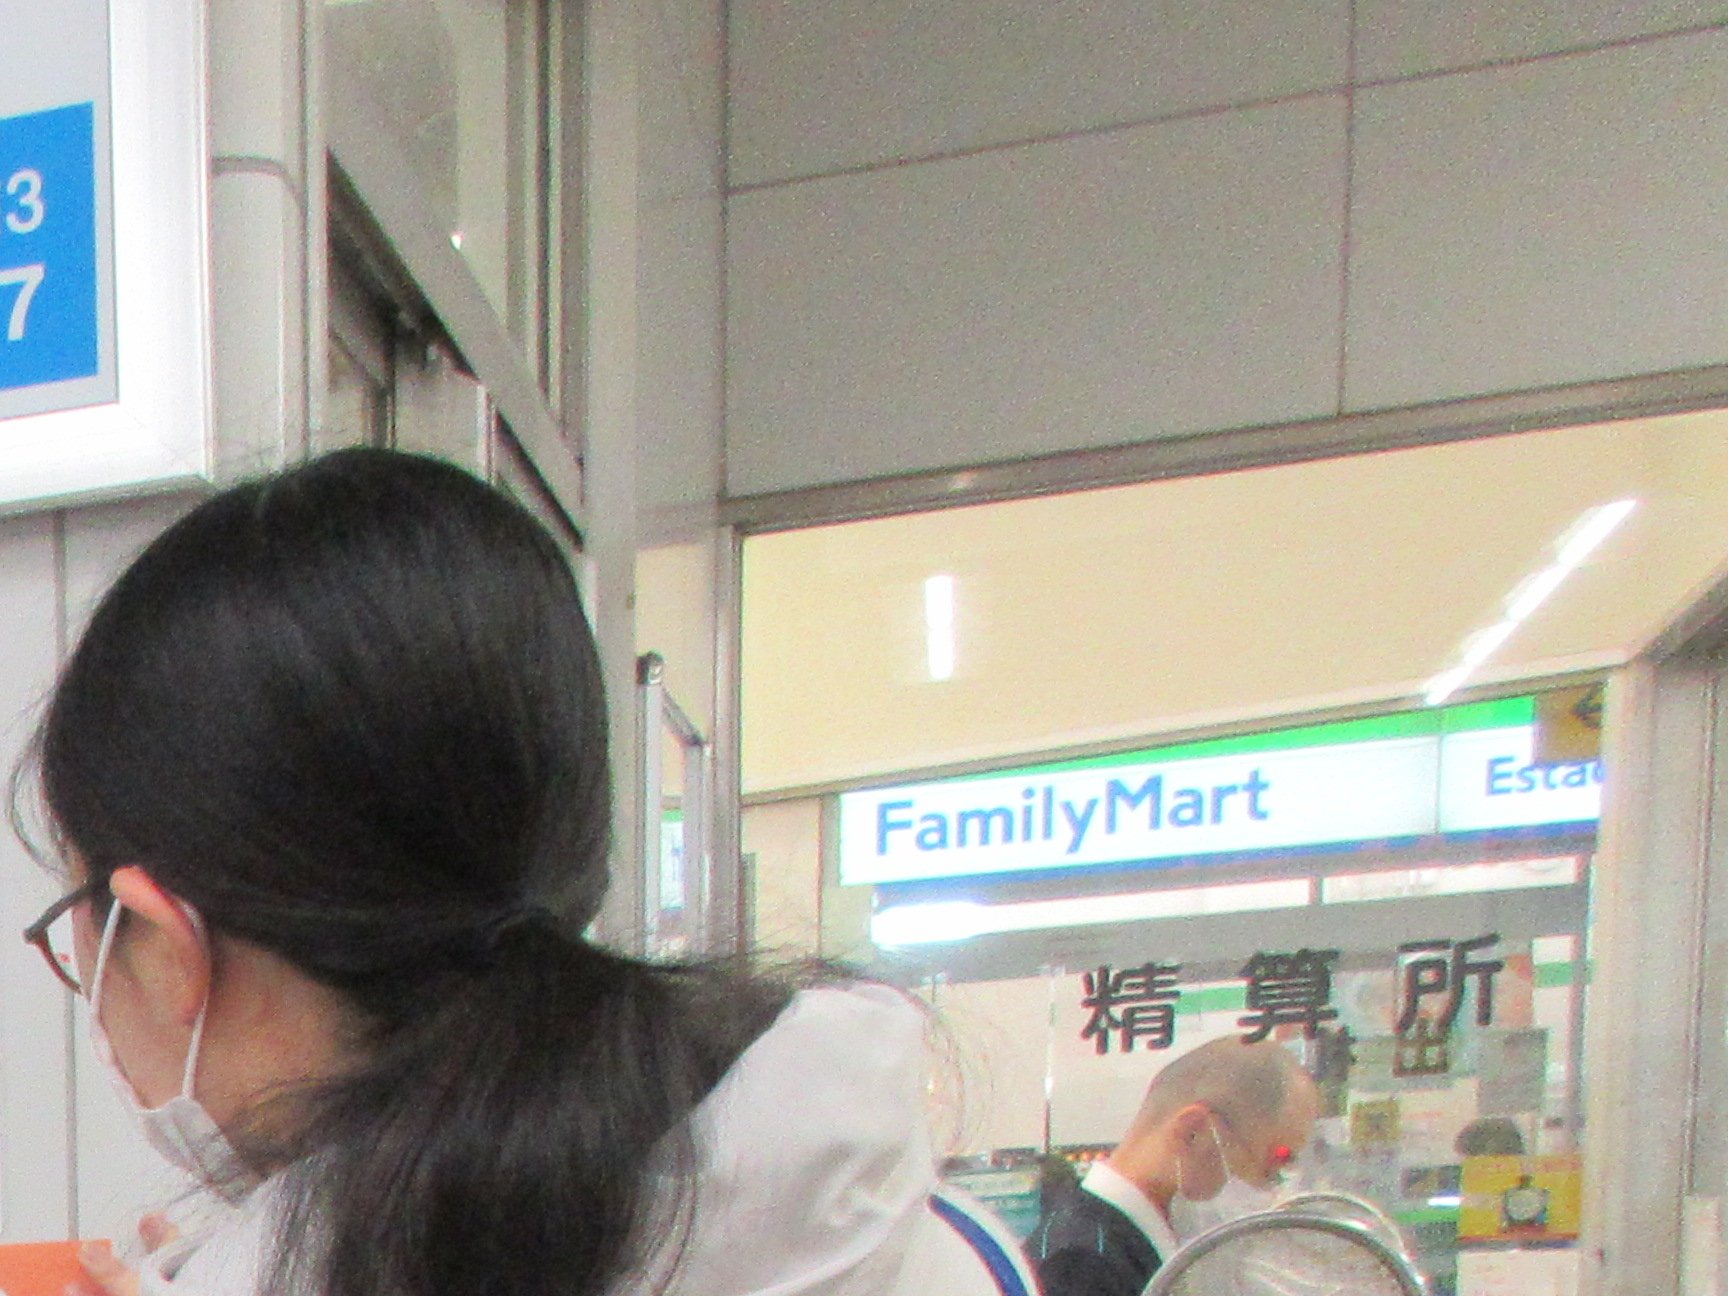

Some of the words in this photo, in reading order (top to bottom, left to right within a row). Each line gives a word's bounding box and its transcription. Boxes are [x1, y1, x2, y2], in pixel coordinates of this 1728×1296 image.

[875, 767, 1271, 856] FamilyMart
[1079, 931, 1505, 1055] 精算所
